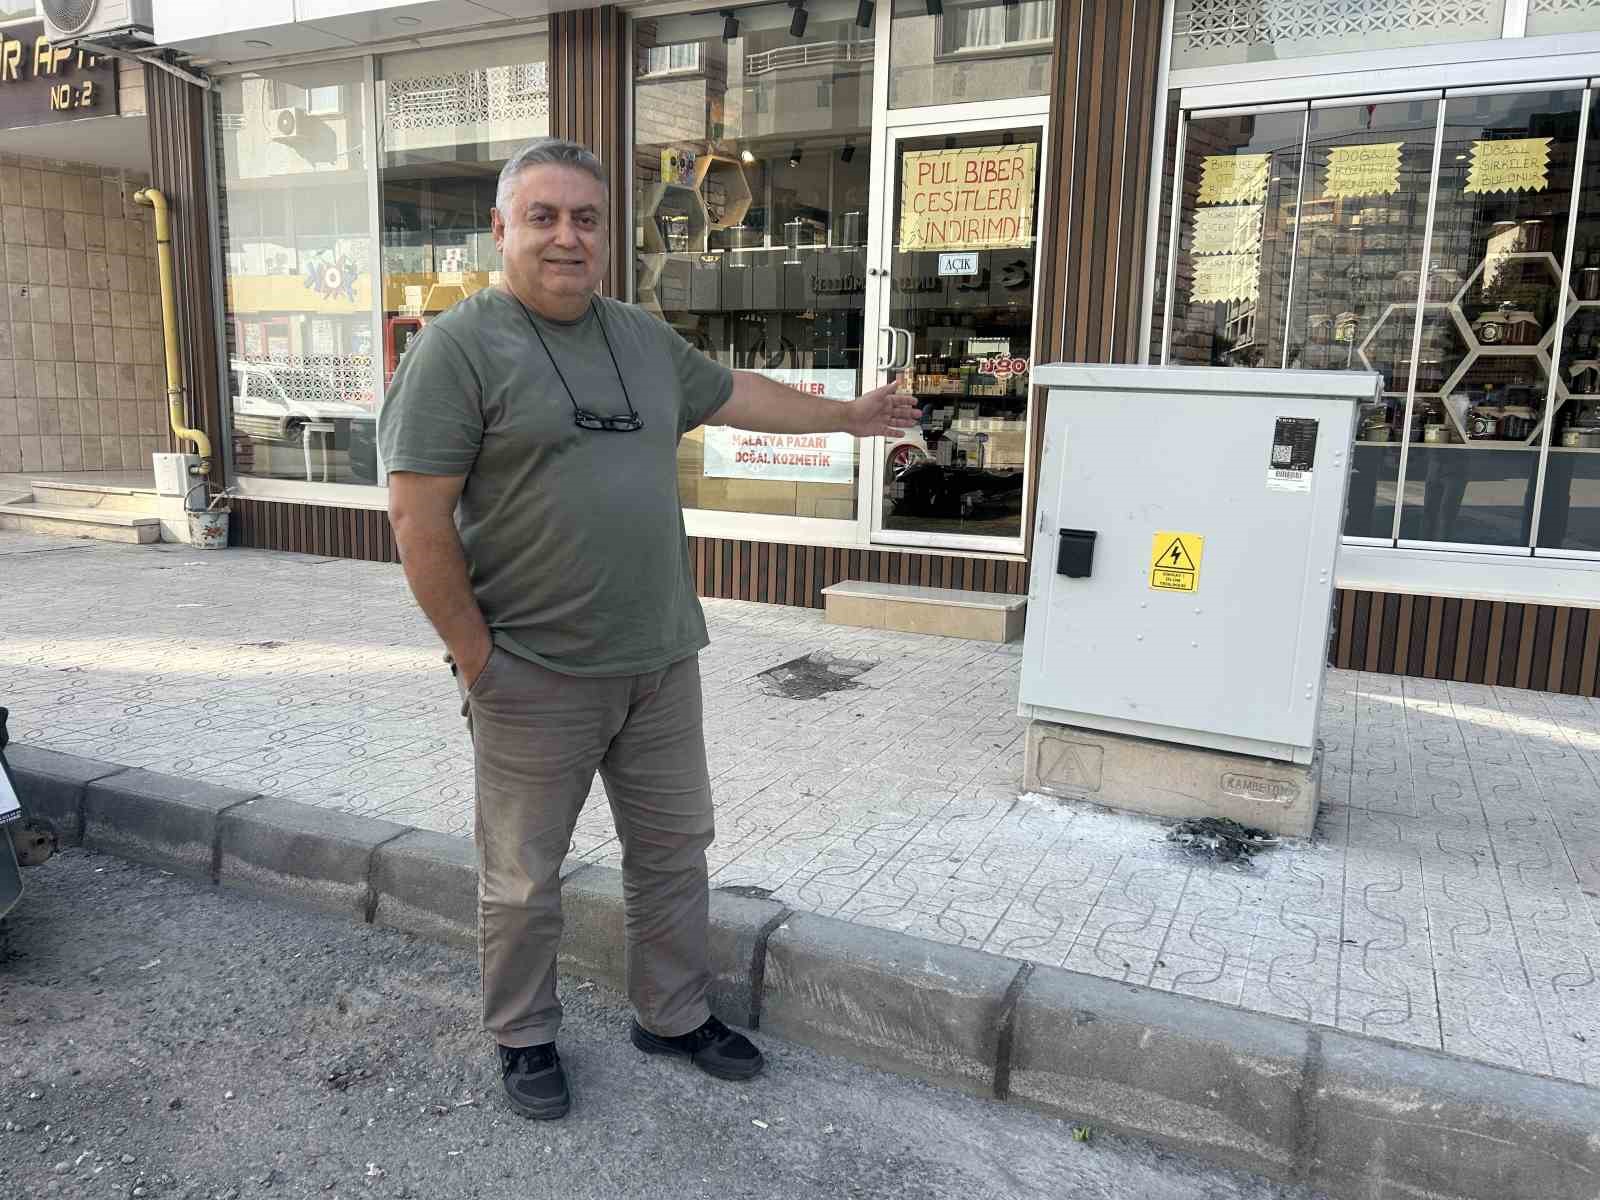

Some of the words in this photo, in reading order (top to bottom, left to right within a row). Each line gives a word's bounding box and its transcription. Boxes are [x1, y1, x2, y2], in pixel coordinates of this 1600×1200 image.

[917, 161, 957, 186] PUL
[963, 156, 1025, 184] BİBER
[944, 257, 971, 273] AÇIK
[732, 434, 784, 448] MALATYA
[735, 449, 771, 465] DOĞAL
[773, 452, 831, 467] KOZMETİK
